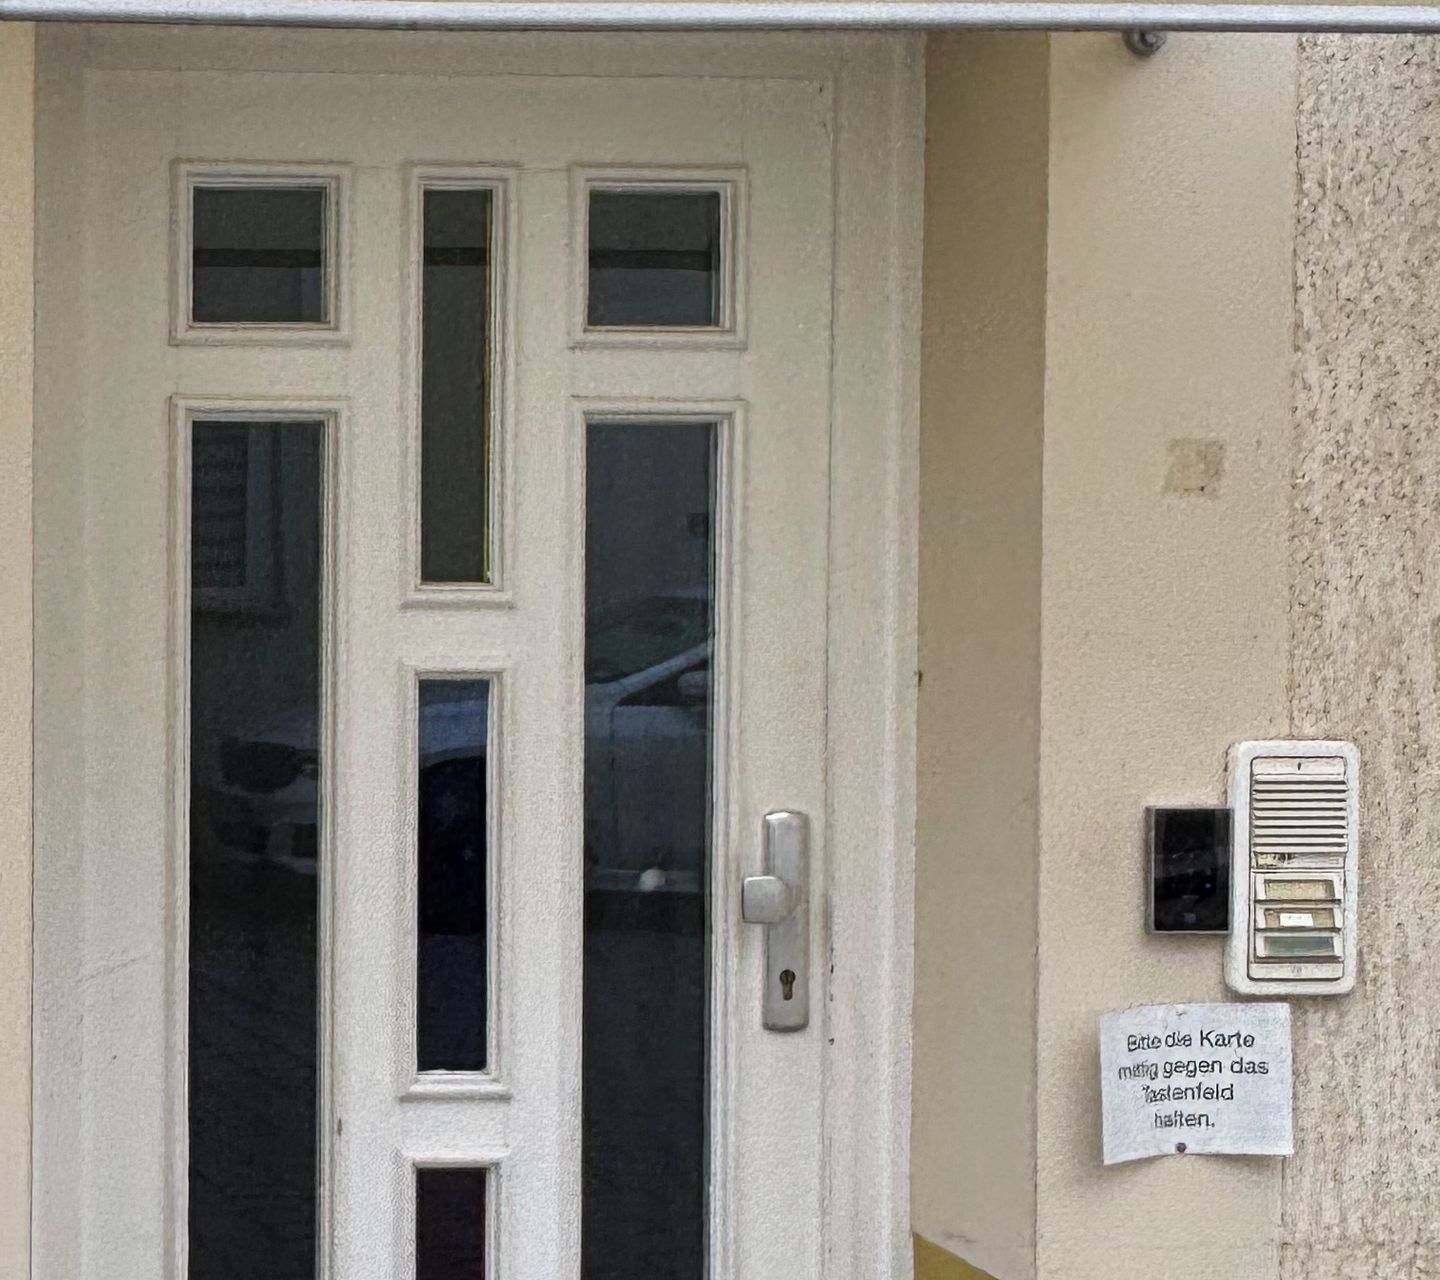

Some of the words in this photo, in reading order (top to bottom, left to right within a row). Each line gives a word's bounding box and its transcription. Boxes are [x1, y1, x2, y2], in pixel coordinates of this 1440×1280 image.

[1165, 1031, 1192, 1047] die
[1200, 1029, 1255, 1048] Karte
[1163, 1060, 1222, 1078] gegen
[1230, 1058, 1269, 1074] das
[1154, 1110, 1215, 1128] halten.
